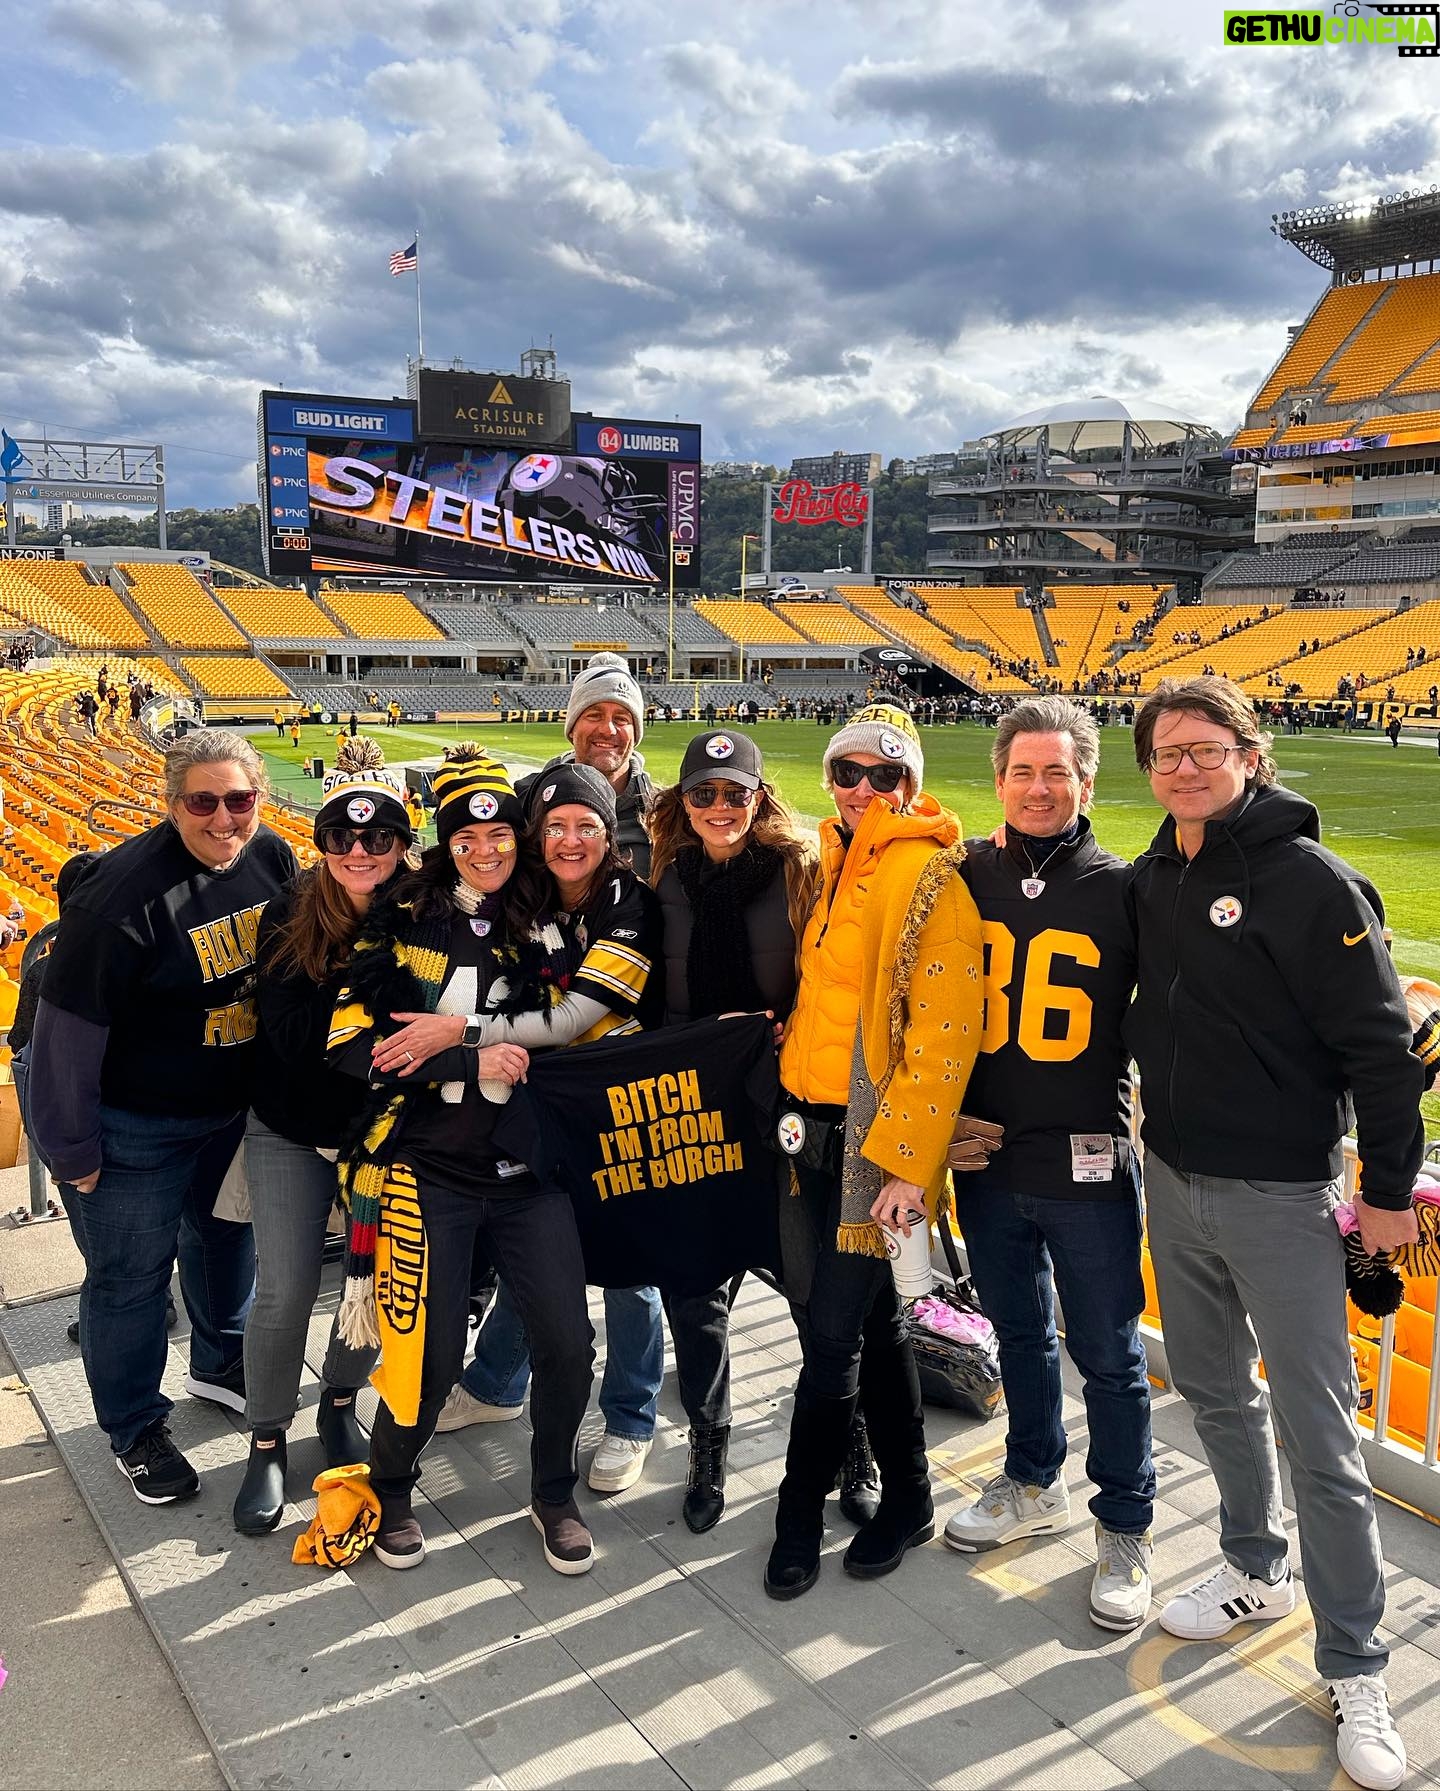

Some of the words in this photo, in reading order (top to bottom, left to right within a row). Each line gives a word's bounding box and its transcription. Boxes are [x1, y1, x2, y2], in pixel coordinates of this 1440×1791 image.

[296, 411, 332, 427] BUD
[335, 413, 384, 430] LIGHT
[455, 407, 544, 425] ACRISURE
[474, 424, 527, 437] STADIUM
[601, 431, 620, 449] 84
[623, 436, 680, 452] LUMBER
[283, 447, 306, 457] PNC
[283, 478, 306, 488] PNC
[15, 489, 28, 497] An
[40, 489, 80, 498] Essential
[82, 490, 115, 500] Utilities
[117, 492, 158, 503] Company
[285, 509, 308, 519] PNC
[678, 471, 695, 540] UPMC
[309, 456, 597, 567] STEELERS
[598, 540, 658, 580] WIN
[16, 550, 55, 561] ZONE
[889, 581, 915, 589] FORD
[917, 581, 935, 589] FAN
[936, 581, 961, 589] ZONE
[606, 1069, 702, 1128] BITCH
[599, 1127, 644, 1165] I'M
[648, 1110, 725, 1158] FROM
[591, 1162, 646, 1202] THE
[648, 1141, 744, 1189] BURGH
[378, 1269, 390, 1302] The
